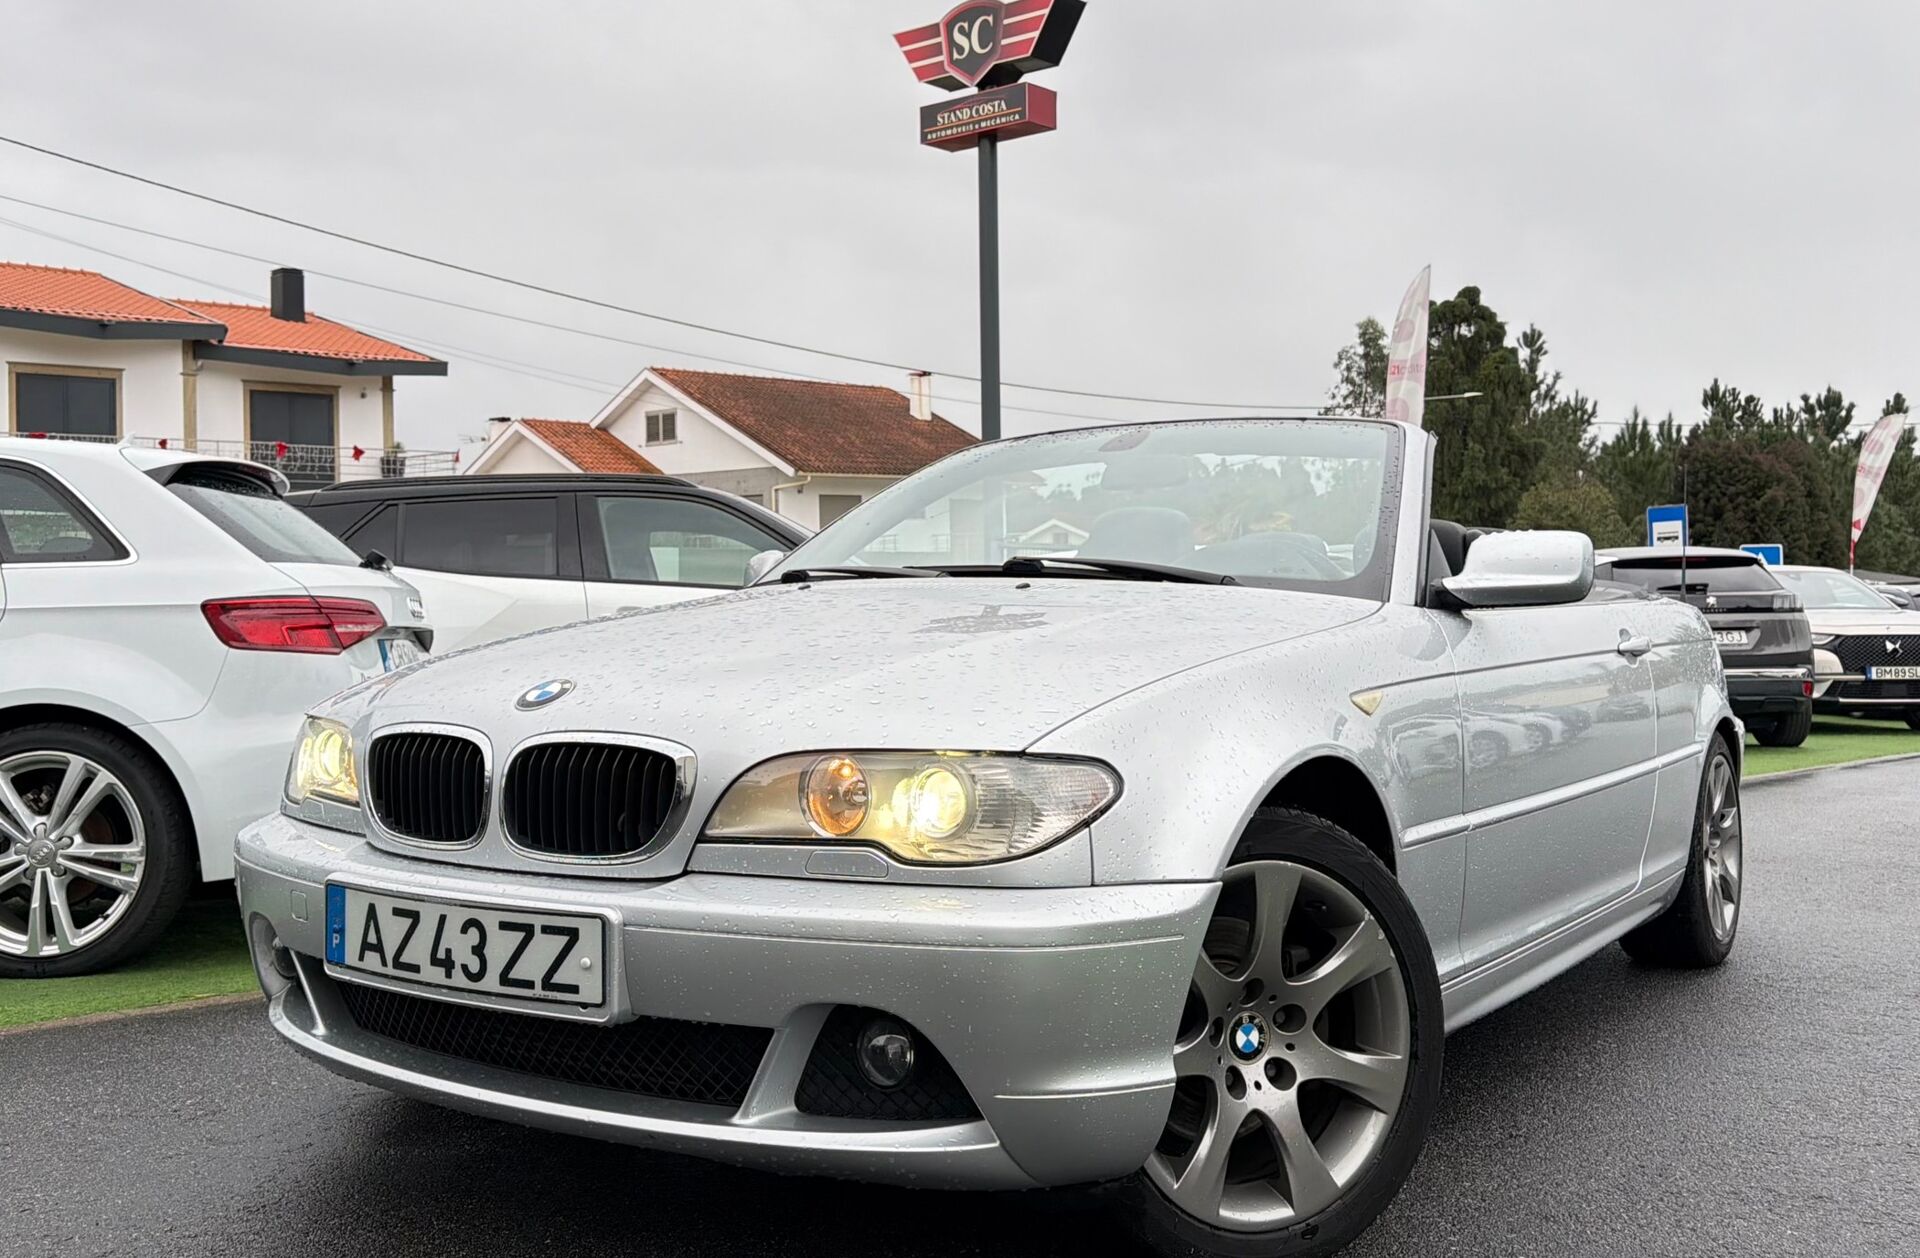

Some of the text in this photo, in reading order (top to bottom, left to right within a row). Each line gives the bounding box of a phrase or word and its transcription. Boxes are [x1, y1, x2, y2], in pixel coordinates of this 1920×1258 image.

[952, 13, 994, 61] SC
[936, 99, 1007, 126] STAND COSTA
[926, 123, 974, 140] AUTOMÓVEIS
[980, 113, 1020, 127] MECÂNICA
[1713, 631, 1743, 643] 3GJ
[1875, 667, 1920, 679] BM89SL
[332, 933, 340, 948] P
[357, 902, 581, 995] AZ43ZZ
